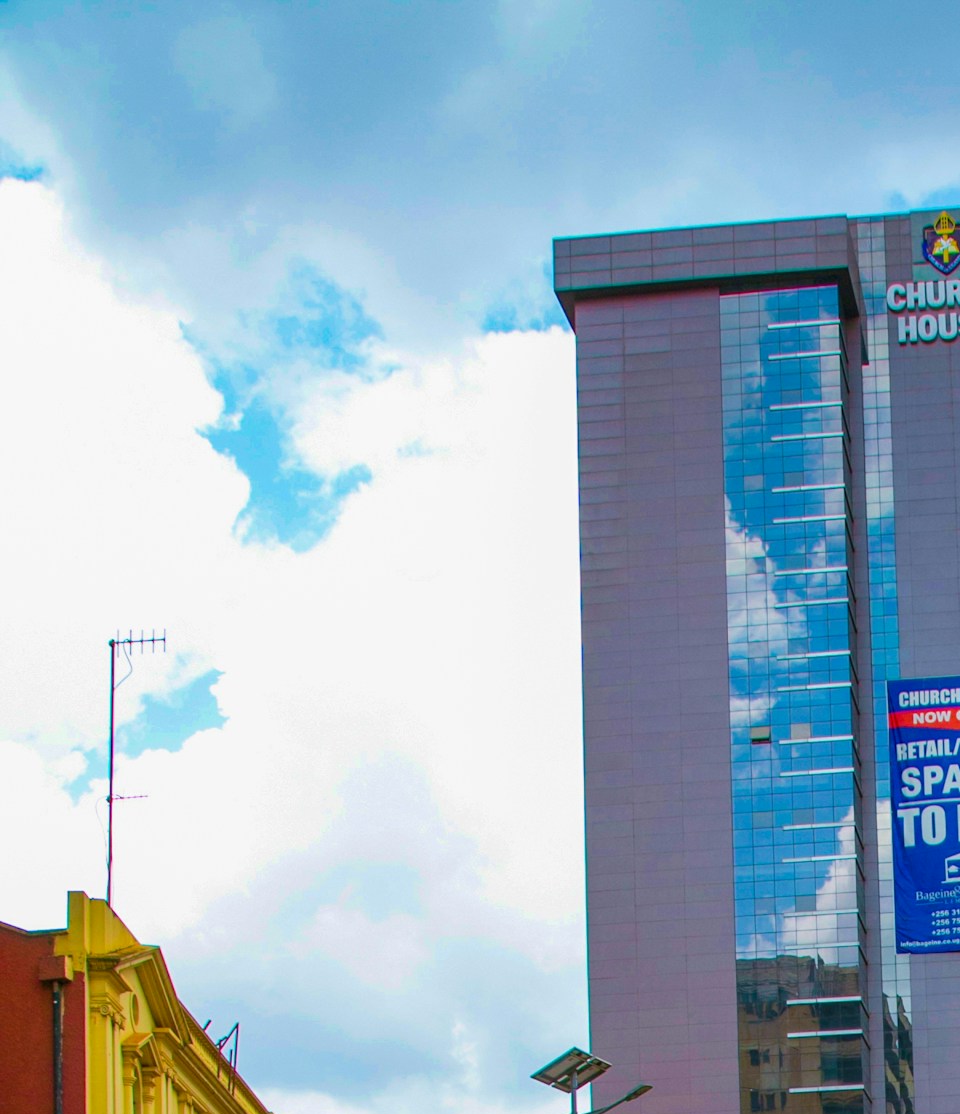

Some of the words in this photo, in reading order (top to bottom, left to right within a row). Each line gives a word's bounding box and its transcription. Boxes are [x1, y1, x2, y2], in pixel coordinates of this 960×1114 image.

[912, 710, 951, 724] NOW
[897, 804, 947, 848] TO
[931, 909, 950, 918] +256
[931, 918, 950, 927] +256
[931, 927, 950, 936] +256
